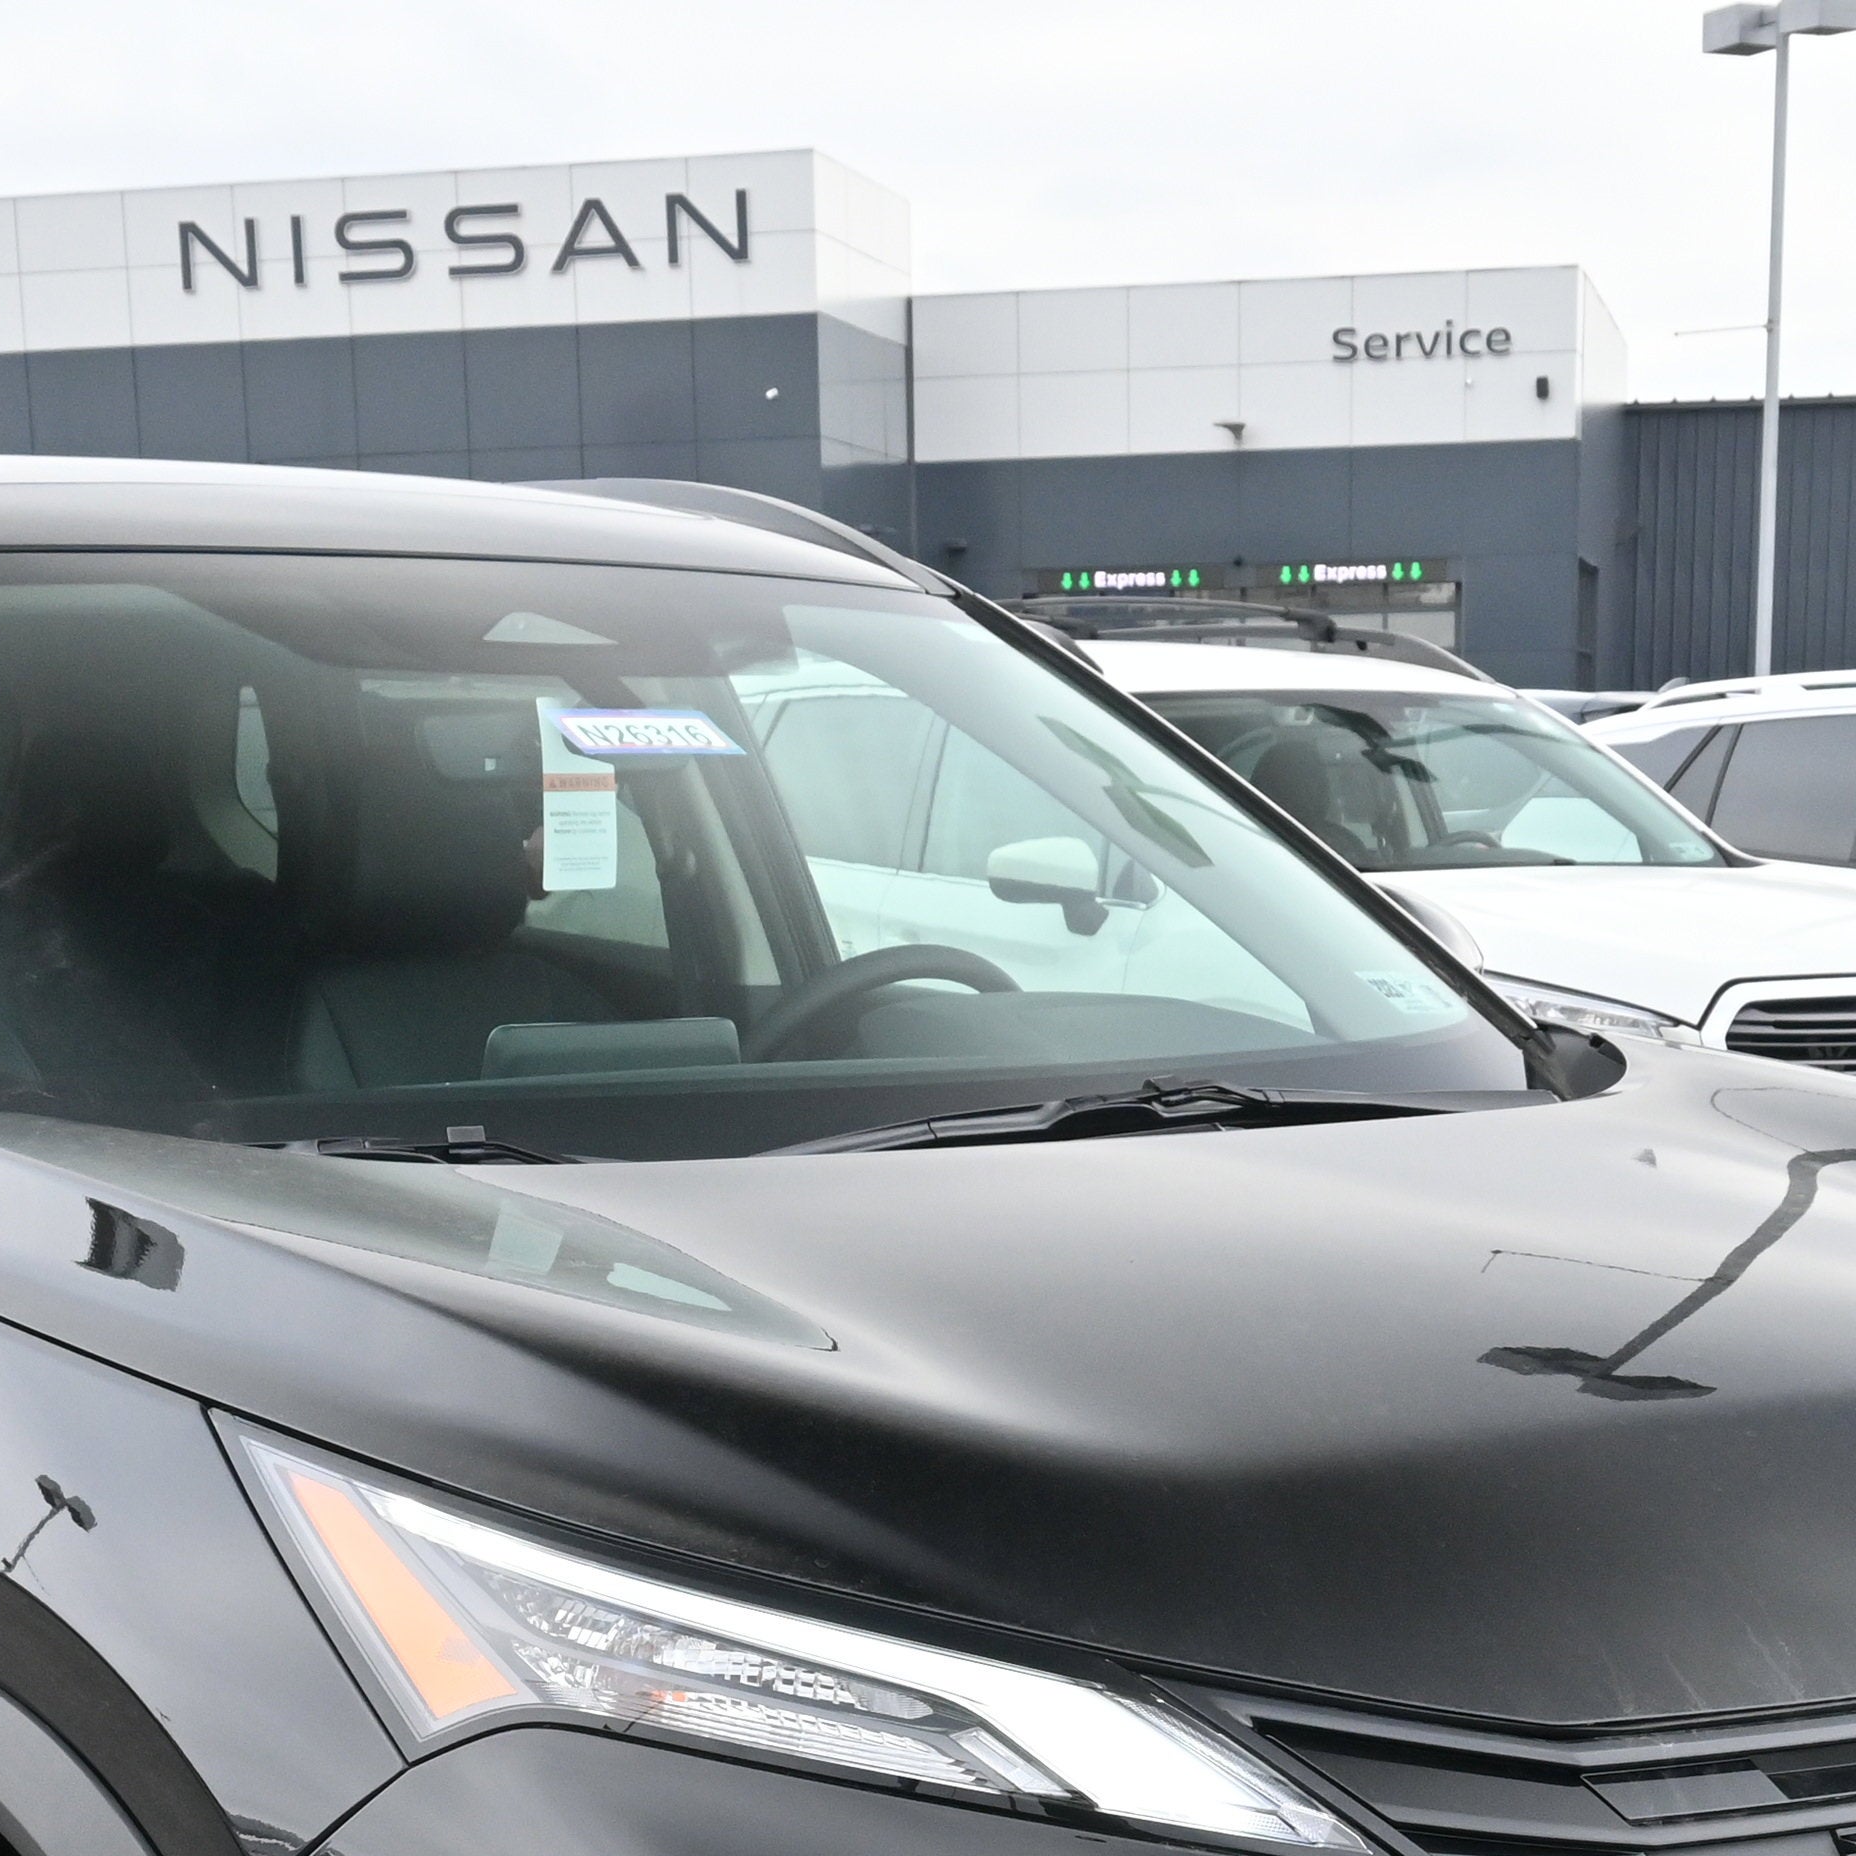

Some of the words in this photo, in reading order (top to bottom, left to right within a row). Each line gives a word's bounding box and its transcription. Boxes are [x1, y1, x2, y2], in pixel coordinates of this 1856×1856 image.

[178, 188, 751, 292] NISSAN
[1332, 319, 1512, 362] Service
[1094, 570, 1165, 590] Express
[1314, 564, 1387, 584] Express
[577, 724, 714, 747] N26316
